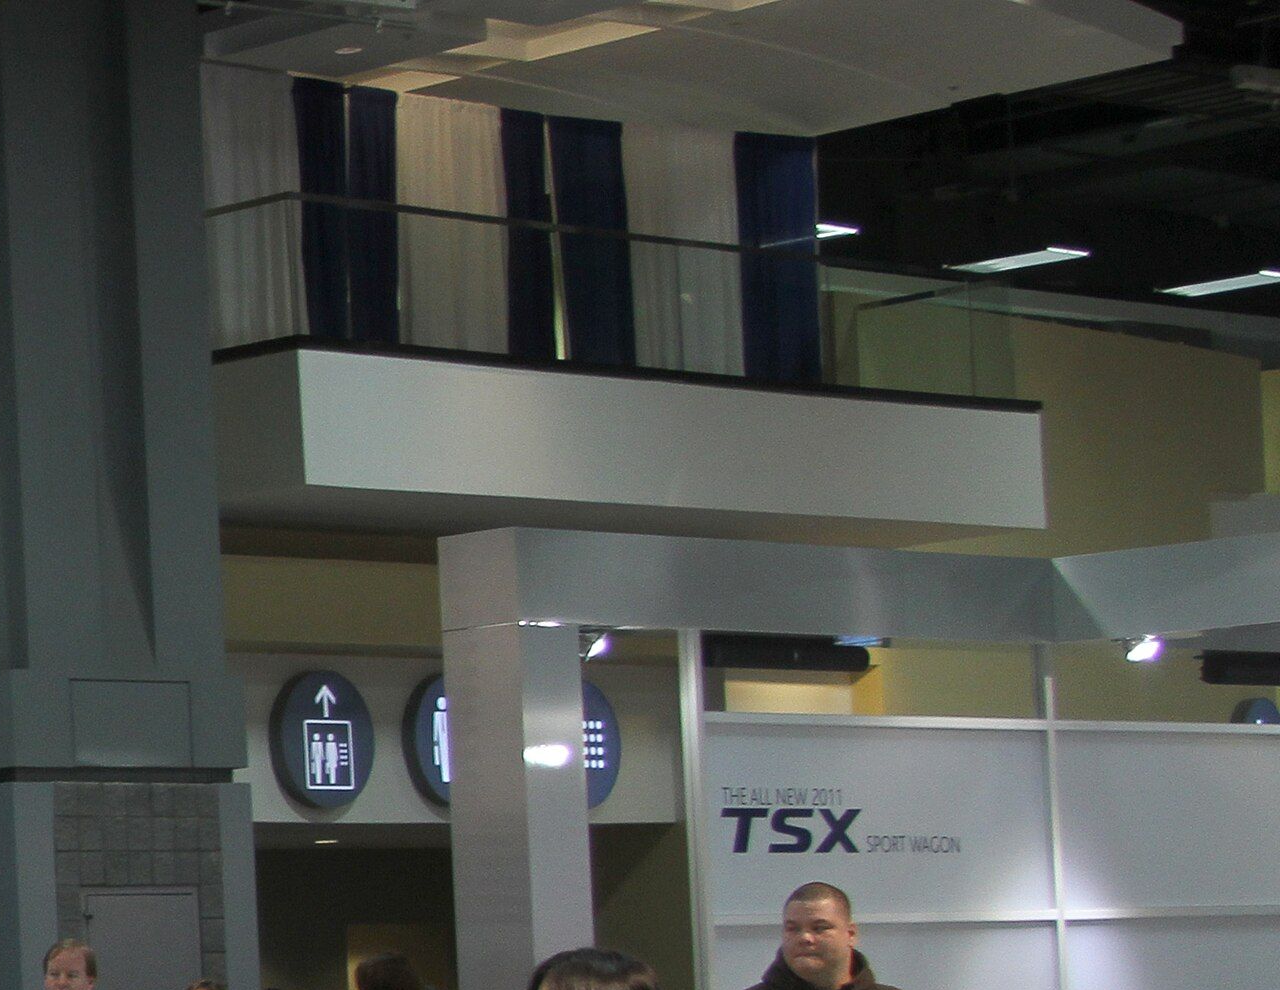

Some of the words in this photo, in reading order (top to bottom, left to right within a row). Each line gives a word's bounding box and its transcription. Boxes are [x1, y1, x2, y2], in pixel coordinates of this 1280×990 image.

[721, 786, 748, 806] THE
[750, 787, 773, 806] ALL
[775, 787, 809, 806] NEW
[811, 787, 842, 807] 2011
[720, 807, 862, 854] TSX
[866, 834, 906, 854] SPORT
[910, 834, 961, 854] WAGON
